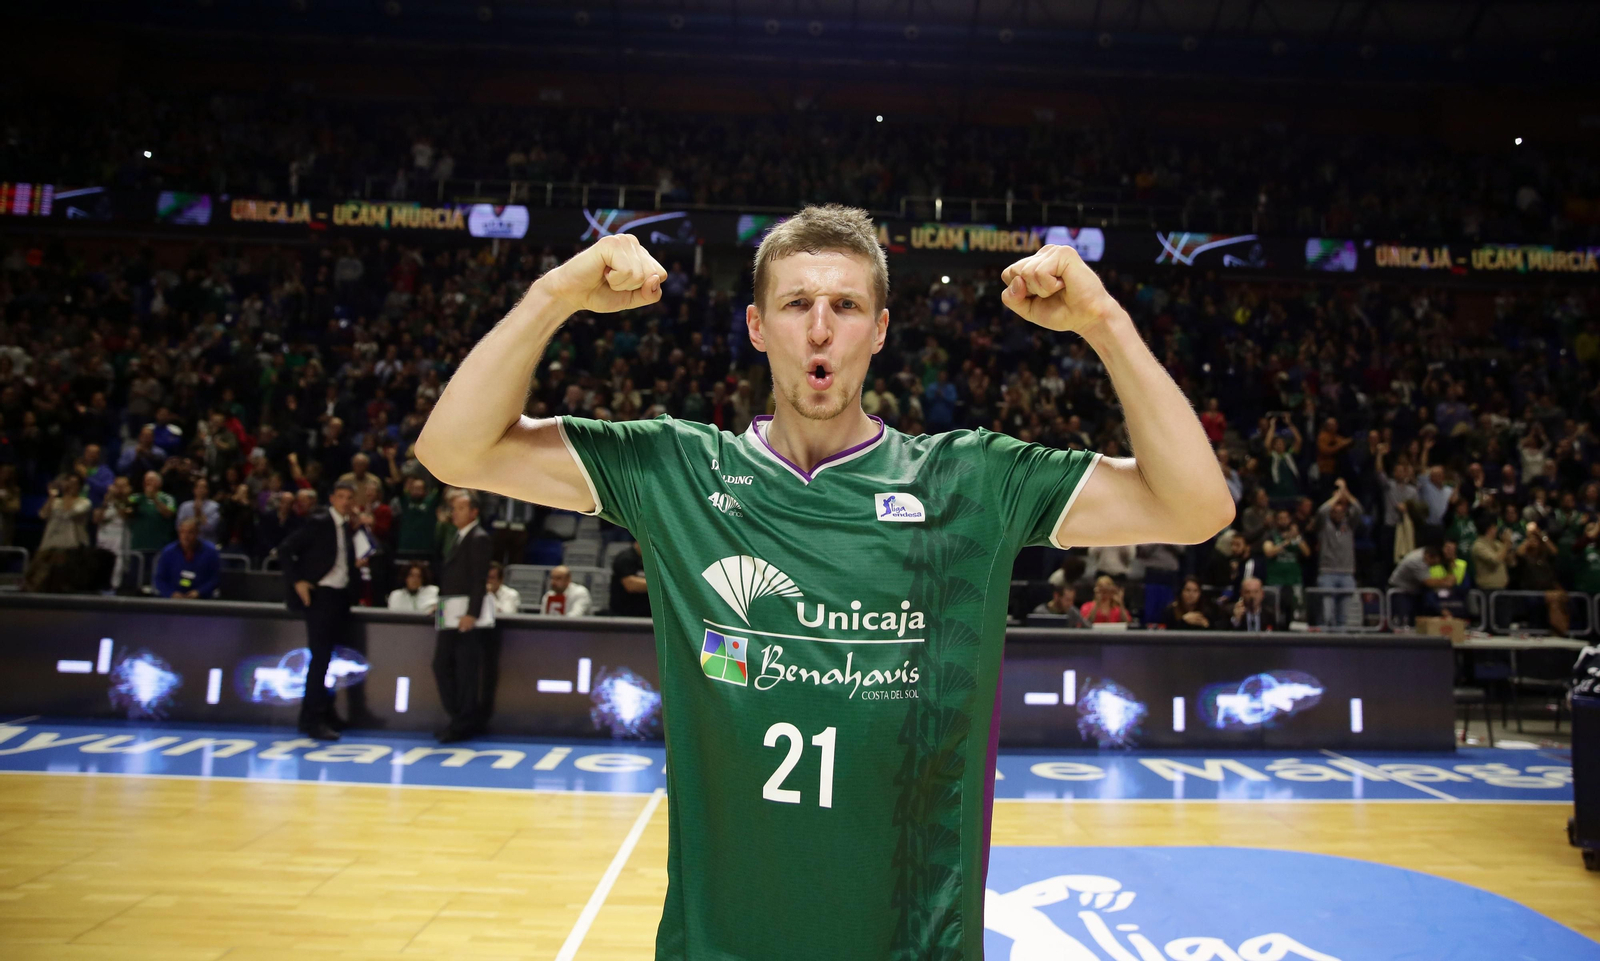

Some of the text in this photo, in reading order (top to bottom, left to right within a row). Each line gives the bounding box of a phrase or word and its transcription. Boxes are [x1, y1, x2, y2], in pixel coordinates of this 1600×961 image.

[231, 199, 311, 223] UNICAJA
[333, 203, 387, 227] UCAM
[389, 206, 465, 231] MURCIA
[910, 227, 966, 249] UCAM
[1375, 244, 1451, 268] UNICAJA
[1471, 246, 1525, 270] UCAM
[891, 503, 906, 513] liga
[797, 600, 925, 637] Unicaja
[862, 690, 919, 700] COSTA DEL SOL
[763, 722, 837, 808] 21
